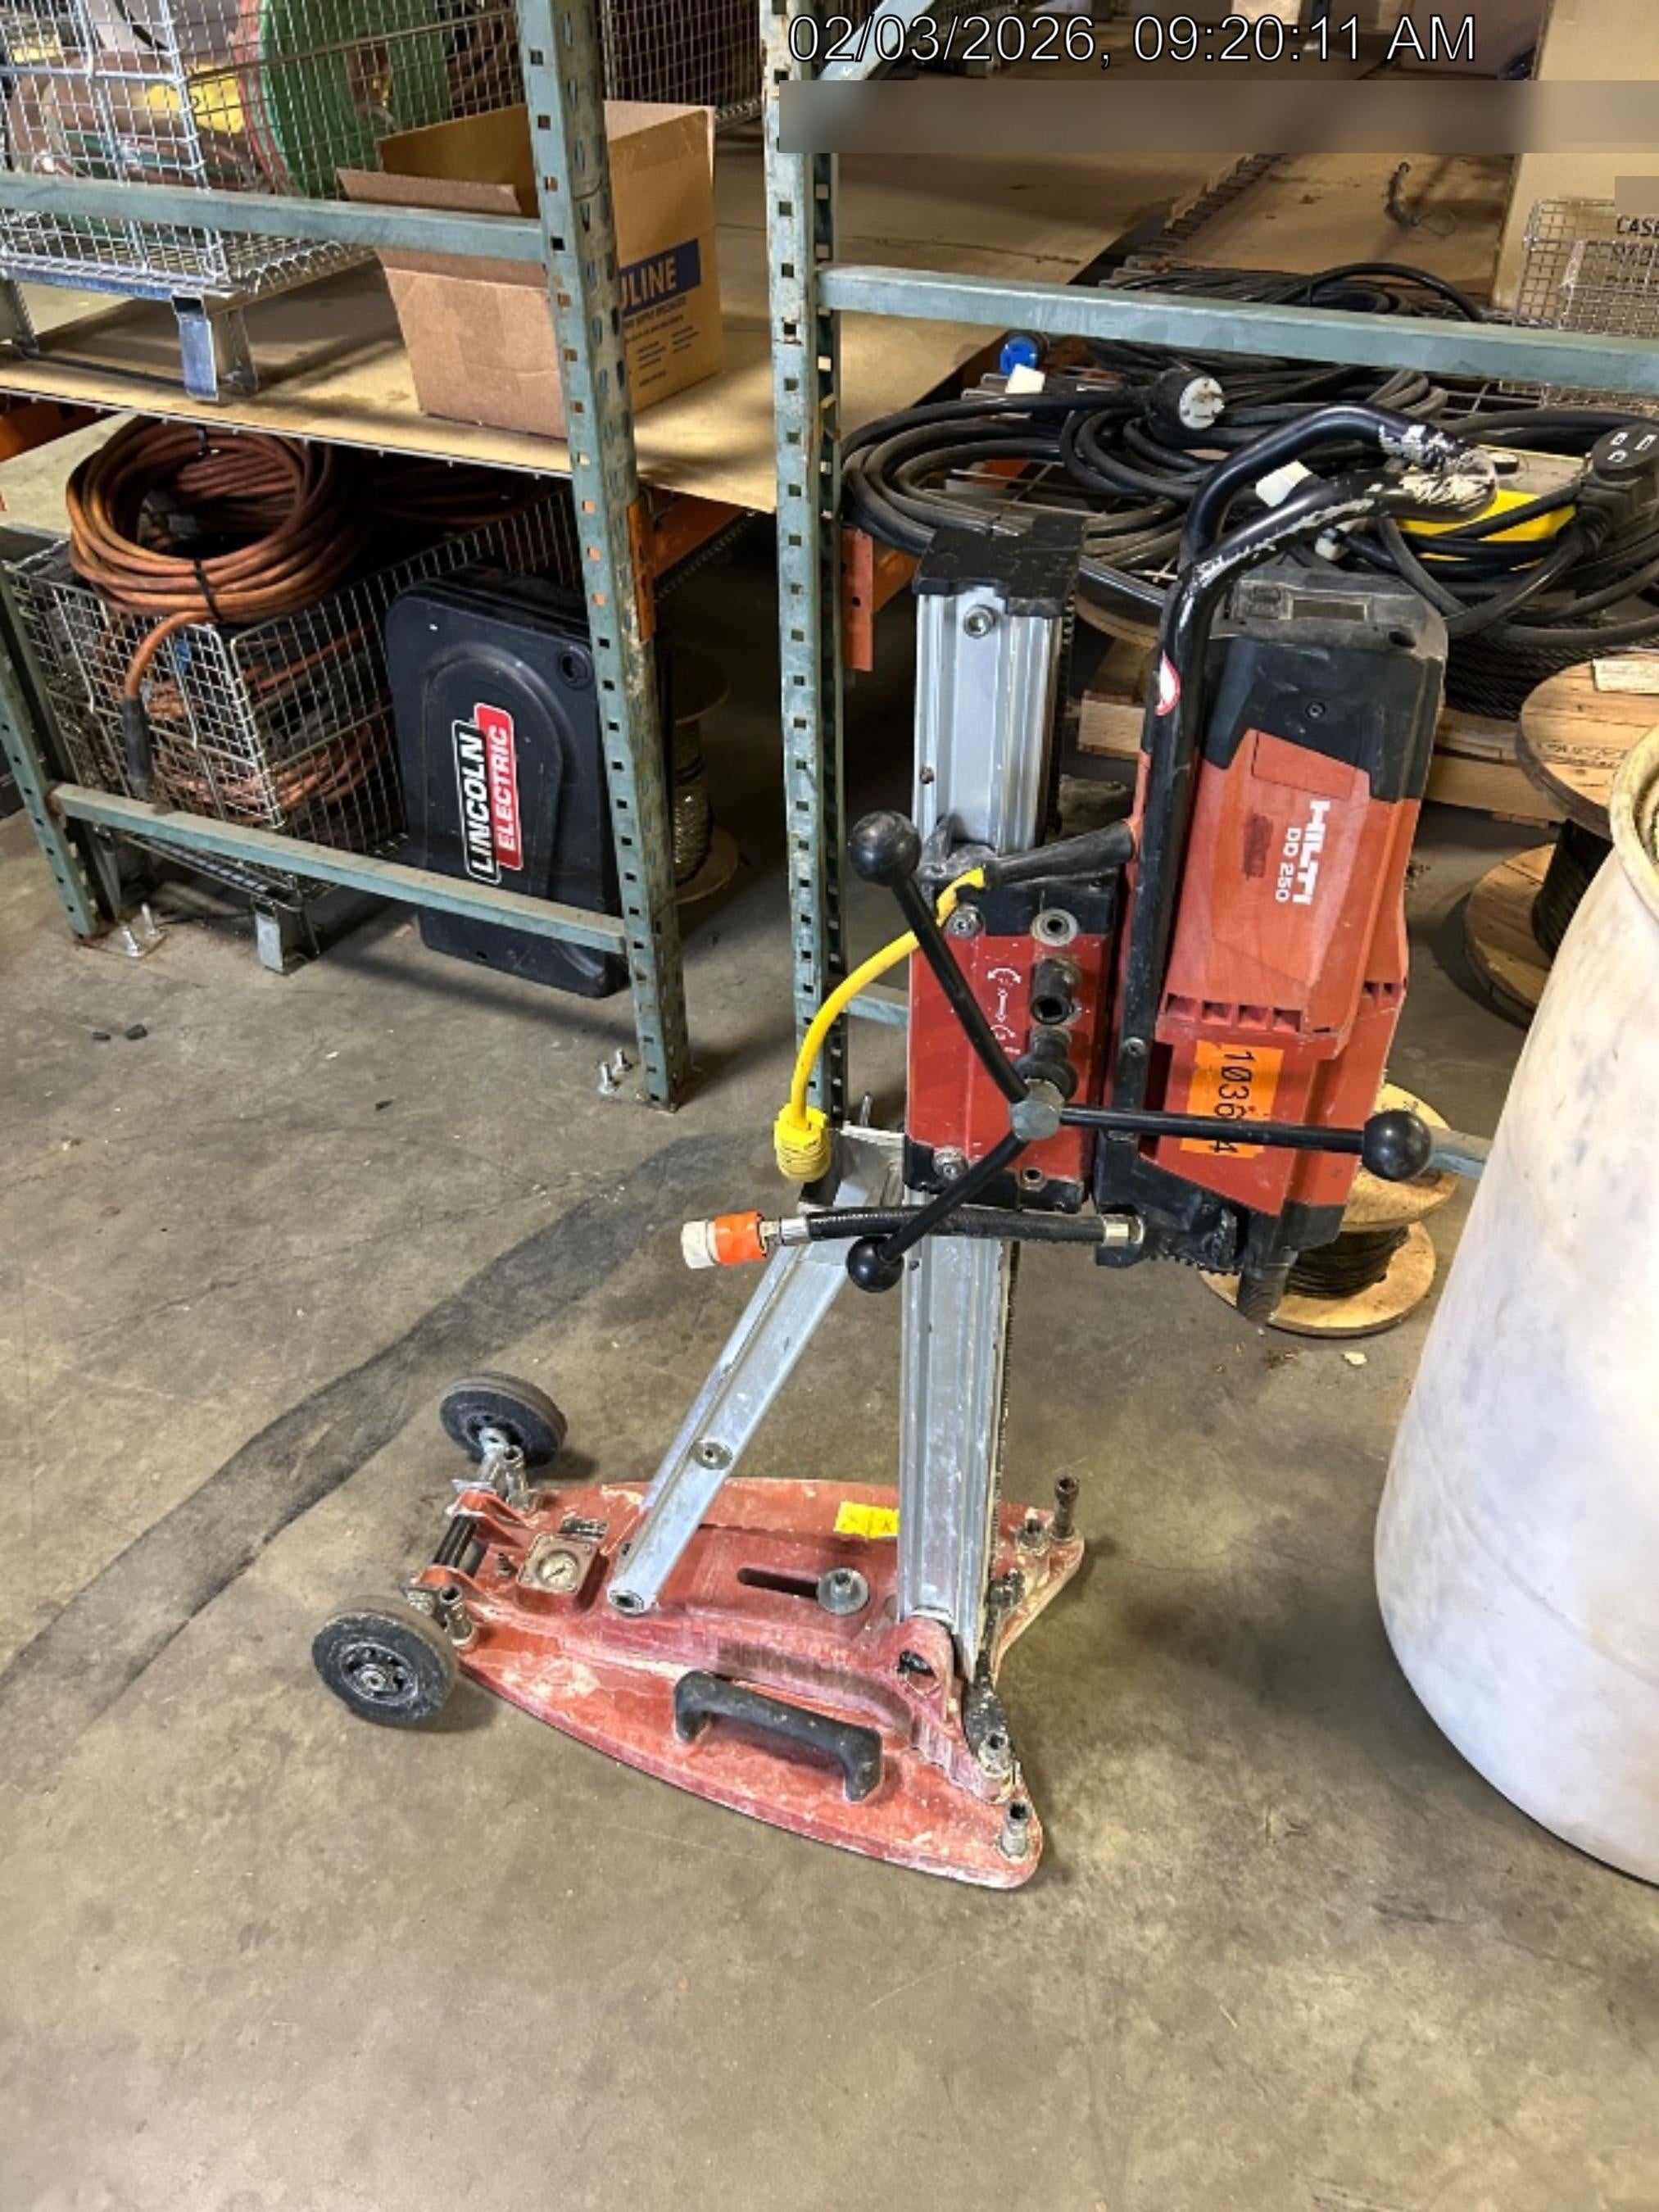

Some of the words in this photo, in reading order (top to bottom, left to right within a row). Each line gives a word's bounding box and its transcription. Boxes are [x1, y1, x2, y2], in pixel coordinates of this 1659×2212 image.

[458, 732, 495, 873] LINCOLN
[489, 724, 517, 852] ELECTRIC
[1275, 862, 1294, 903] 250
[1283, 827, 1303, 858] DD
[1292, 800, 1330, 905] HILTI
[1208, 1051, 1257, 1153] 10364
